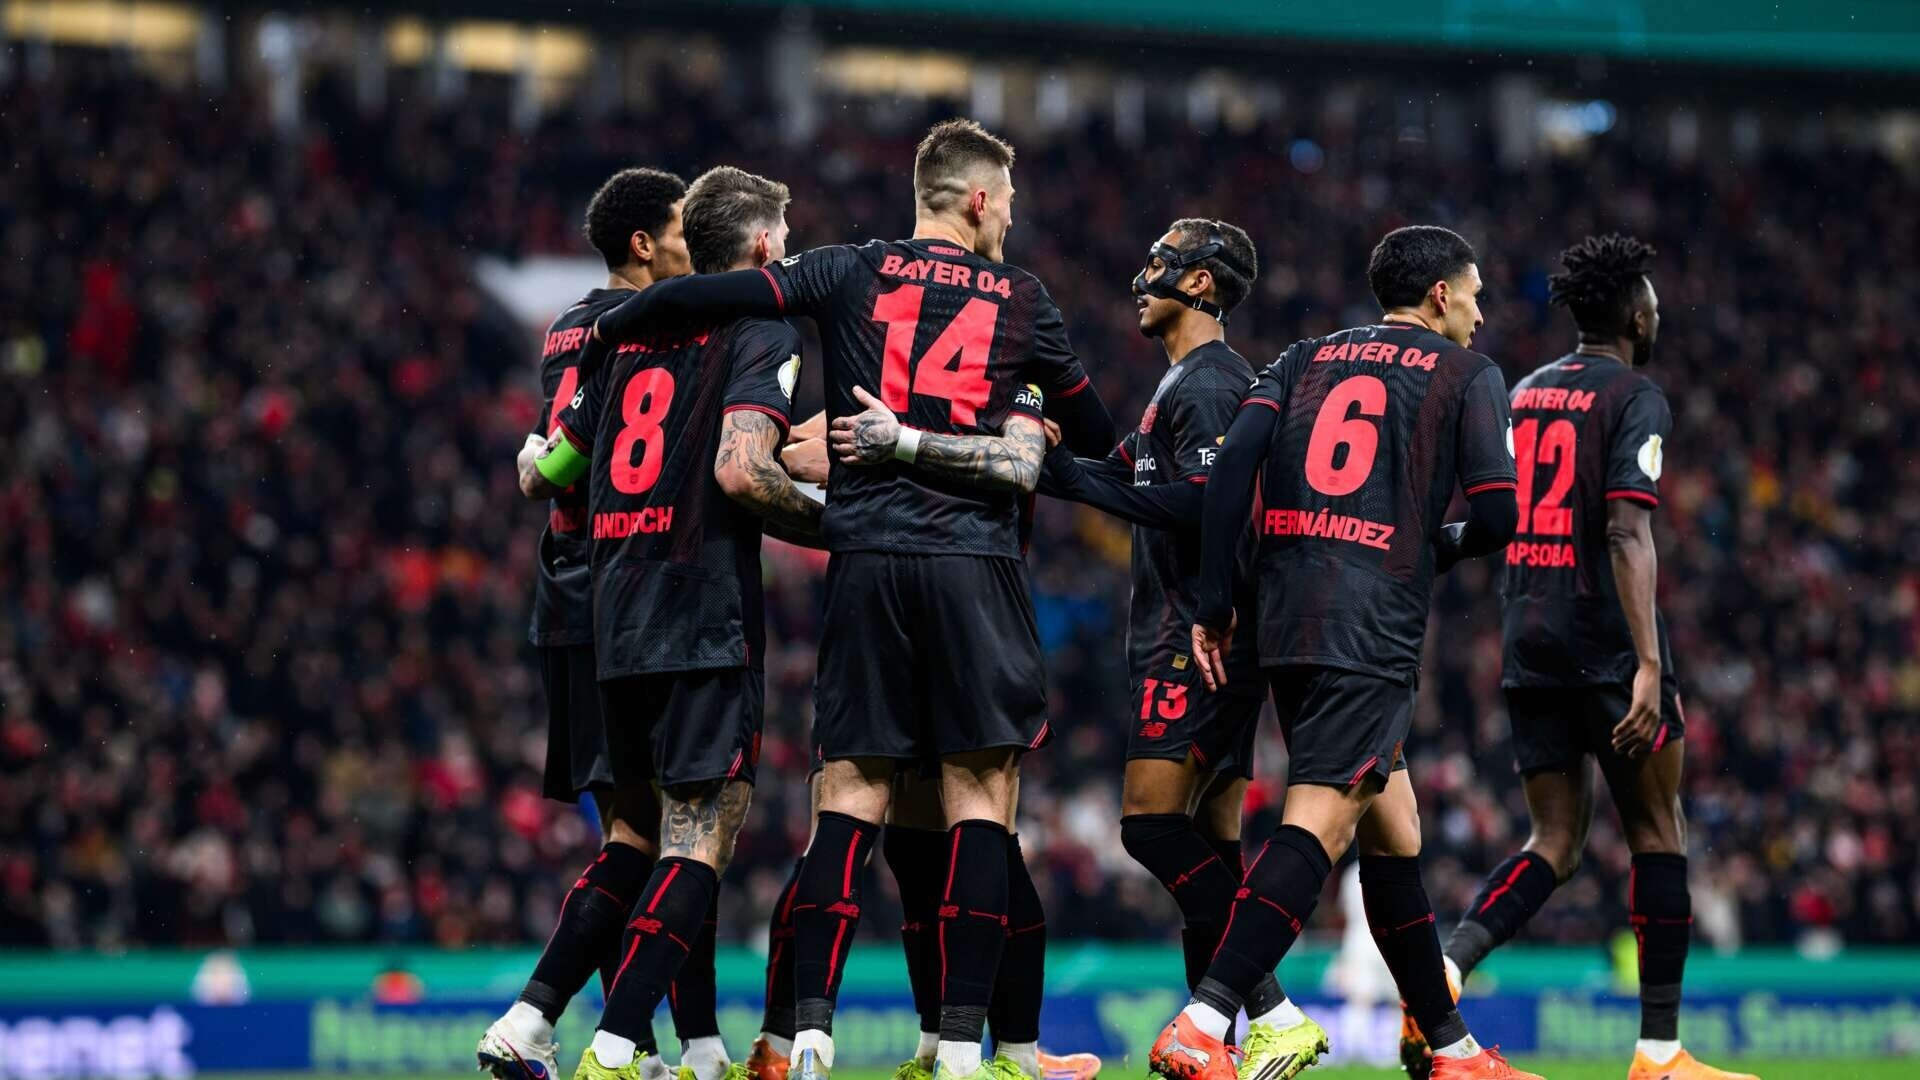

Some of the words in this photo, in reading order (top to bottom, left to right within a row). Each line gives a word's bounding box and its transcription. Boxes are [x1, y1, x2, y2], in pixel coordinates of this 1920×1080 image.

[879, 254, 972, 288] BAYER
[976, 270, 1012, 299] 04
[871, 283, 999, 427] 14
[1312, 342, 1399, 364] BAYER
[1400, 348, 1437, 371] 04
[1014, 390, 1042, 411] alc
[1567, 389, 1597, 413] 04
[610, 367, 675, 495] 8
[1304, 374, 1387, 497] 6
[1136, 453, 1157, 472] enia
[1513, 417, 1577, 536] 12
[593, 506, 674, 539] ANDRCH
[1264, 508, 1396, 551] FERNÁNDEZ
[1505, 541, 1576, 568] APSOBA
[1140, 678, 1189, 720] 13
